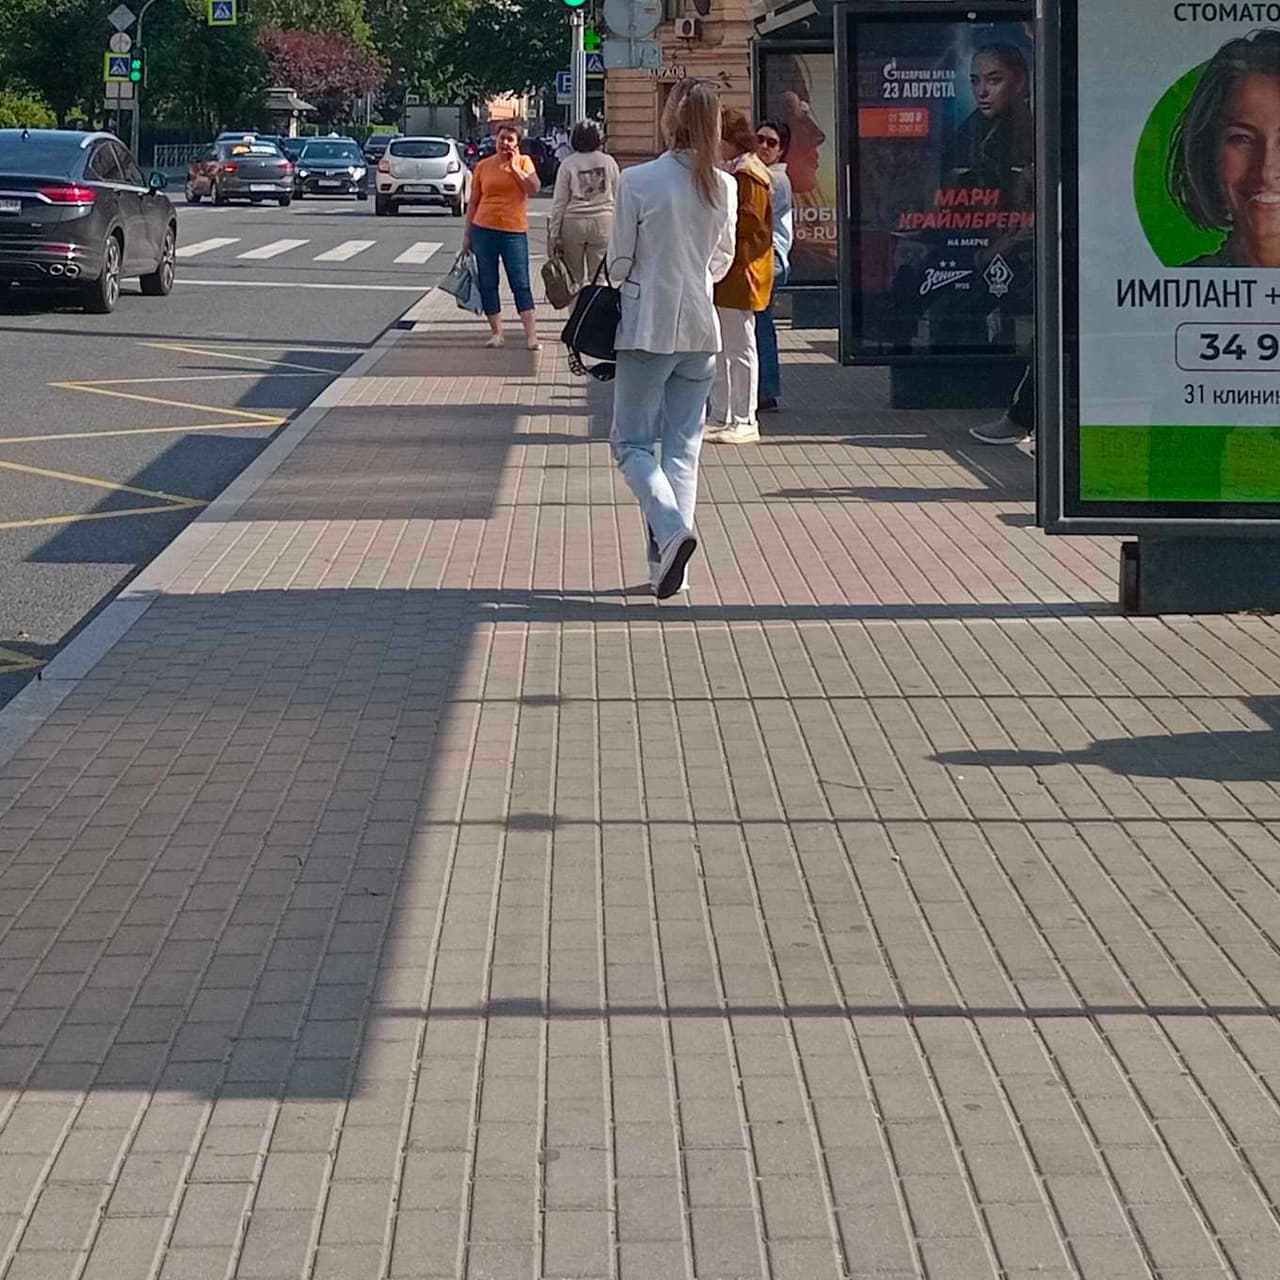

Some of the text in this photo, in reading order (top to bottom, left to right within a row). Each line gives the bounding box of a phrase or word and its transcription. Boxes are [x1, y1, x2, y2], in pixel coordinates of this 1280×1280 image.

[883, 82, 956, 98] 23 АВГУСТА
[933, 187, 1001, 207] МАРИ
[897, 209, 1035, 229] КРАЙМБРЕРИ
[1116, 278, 1258, 308] ИМПЛАНТ
[1199, 333, 1247, 362] 34
[1184, 383, 1206, 404] 31
